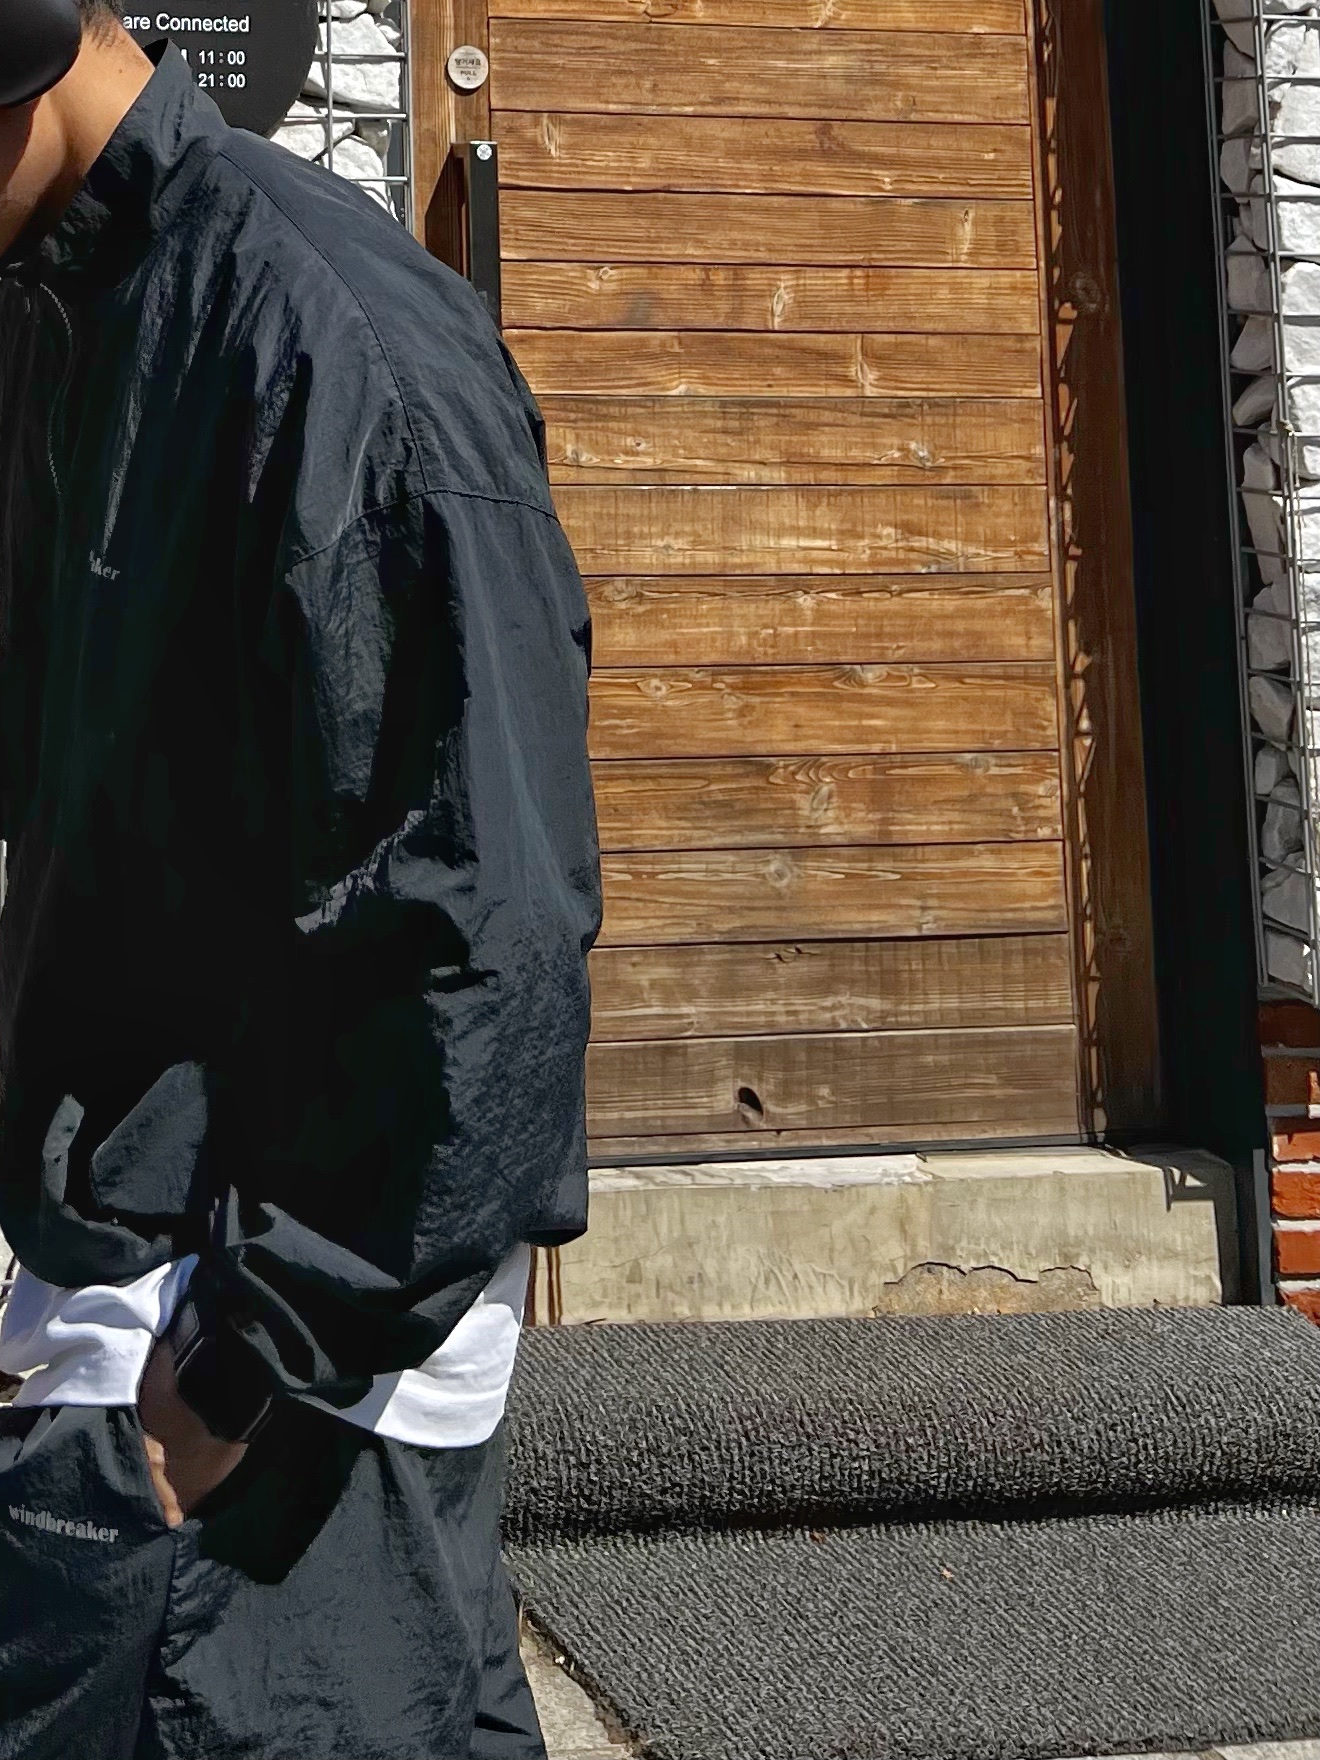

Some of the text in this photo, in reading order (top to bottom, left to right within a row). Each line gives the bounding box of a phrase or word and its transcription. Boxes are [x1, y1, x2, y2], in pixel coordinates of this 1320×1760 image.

[122, 12, 250, 33] are Connected
[198, 50, 246, 65] 11:00
[198, 72, 246, 88] 21:00
[8, 1503, 120, 1544] windbreaker
